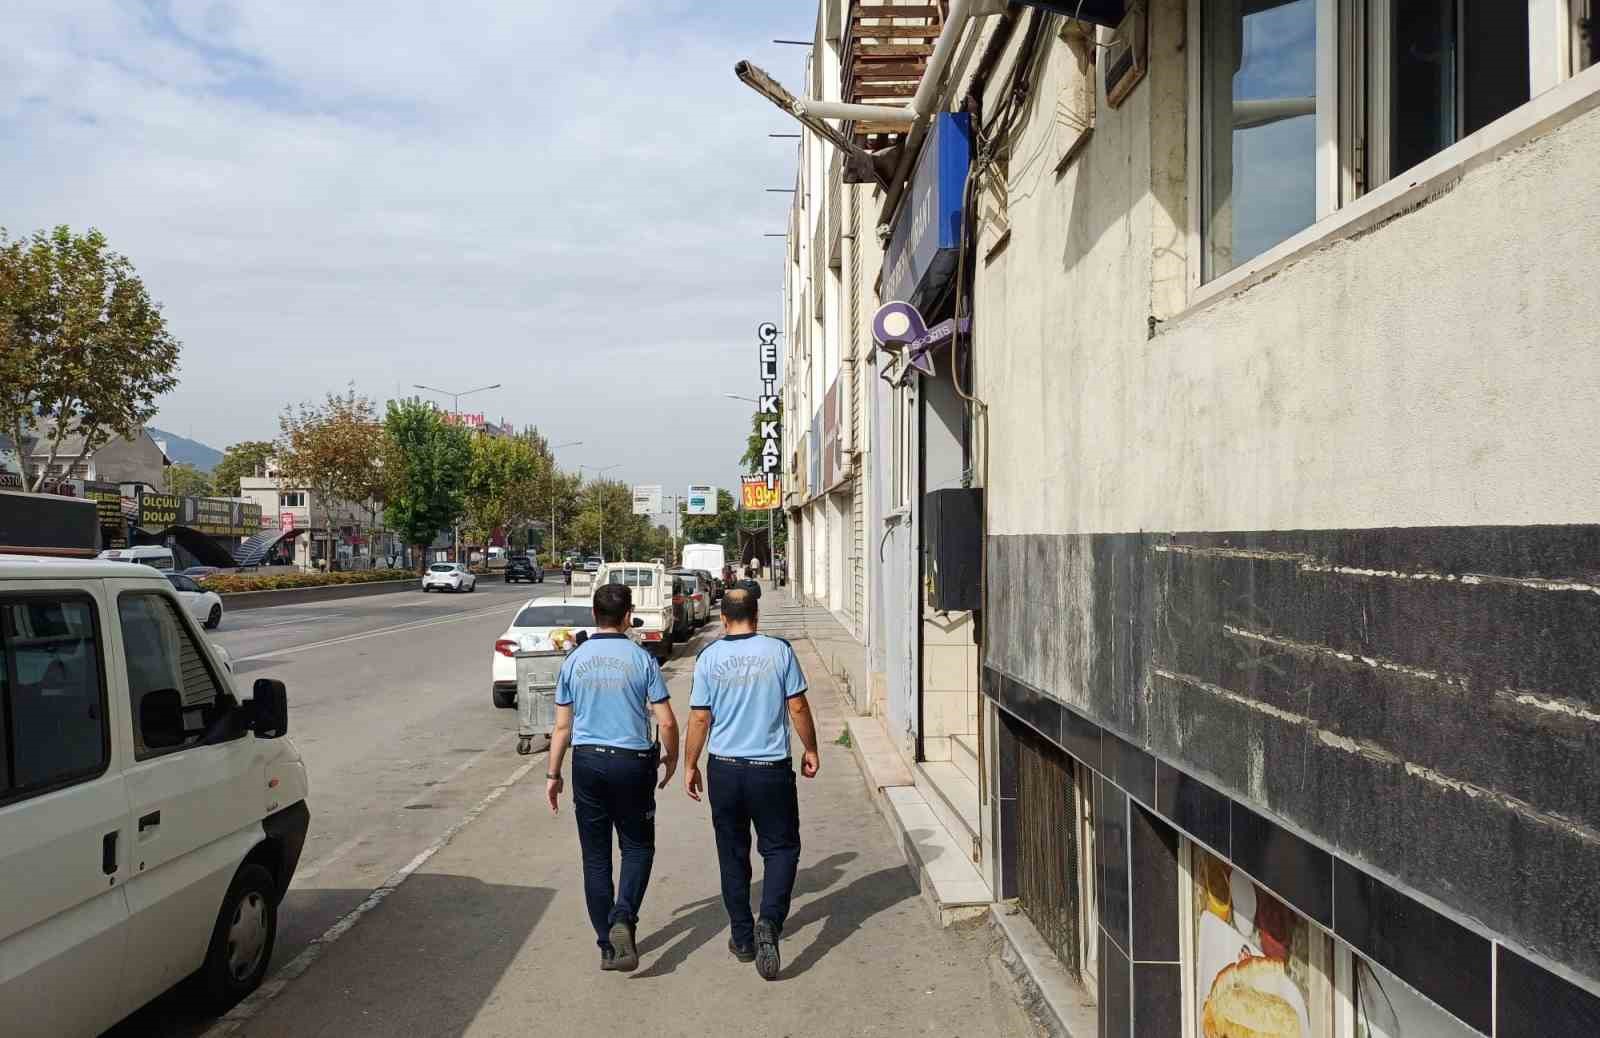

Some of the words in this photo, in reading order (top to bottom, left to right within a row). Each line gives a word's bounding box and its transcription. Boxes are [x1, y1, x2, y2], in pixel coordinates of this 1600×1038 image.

[911, 327, 950, 350] SPORTS
[759, 322, 778, 414] ÇELİK
[760, 420, 779, 490] KAPI
[143, 512, 176, 522] DOLAP
